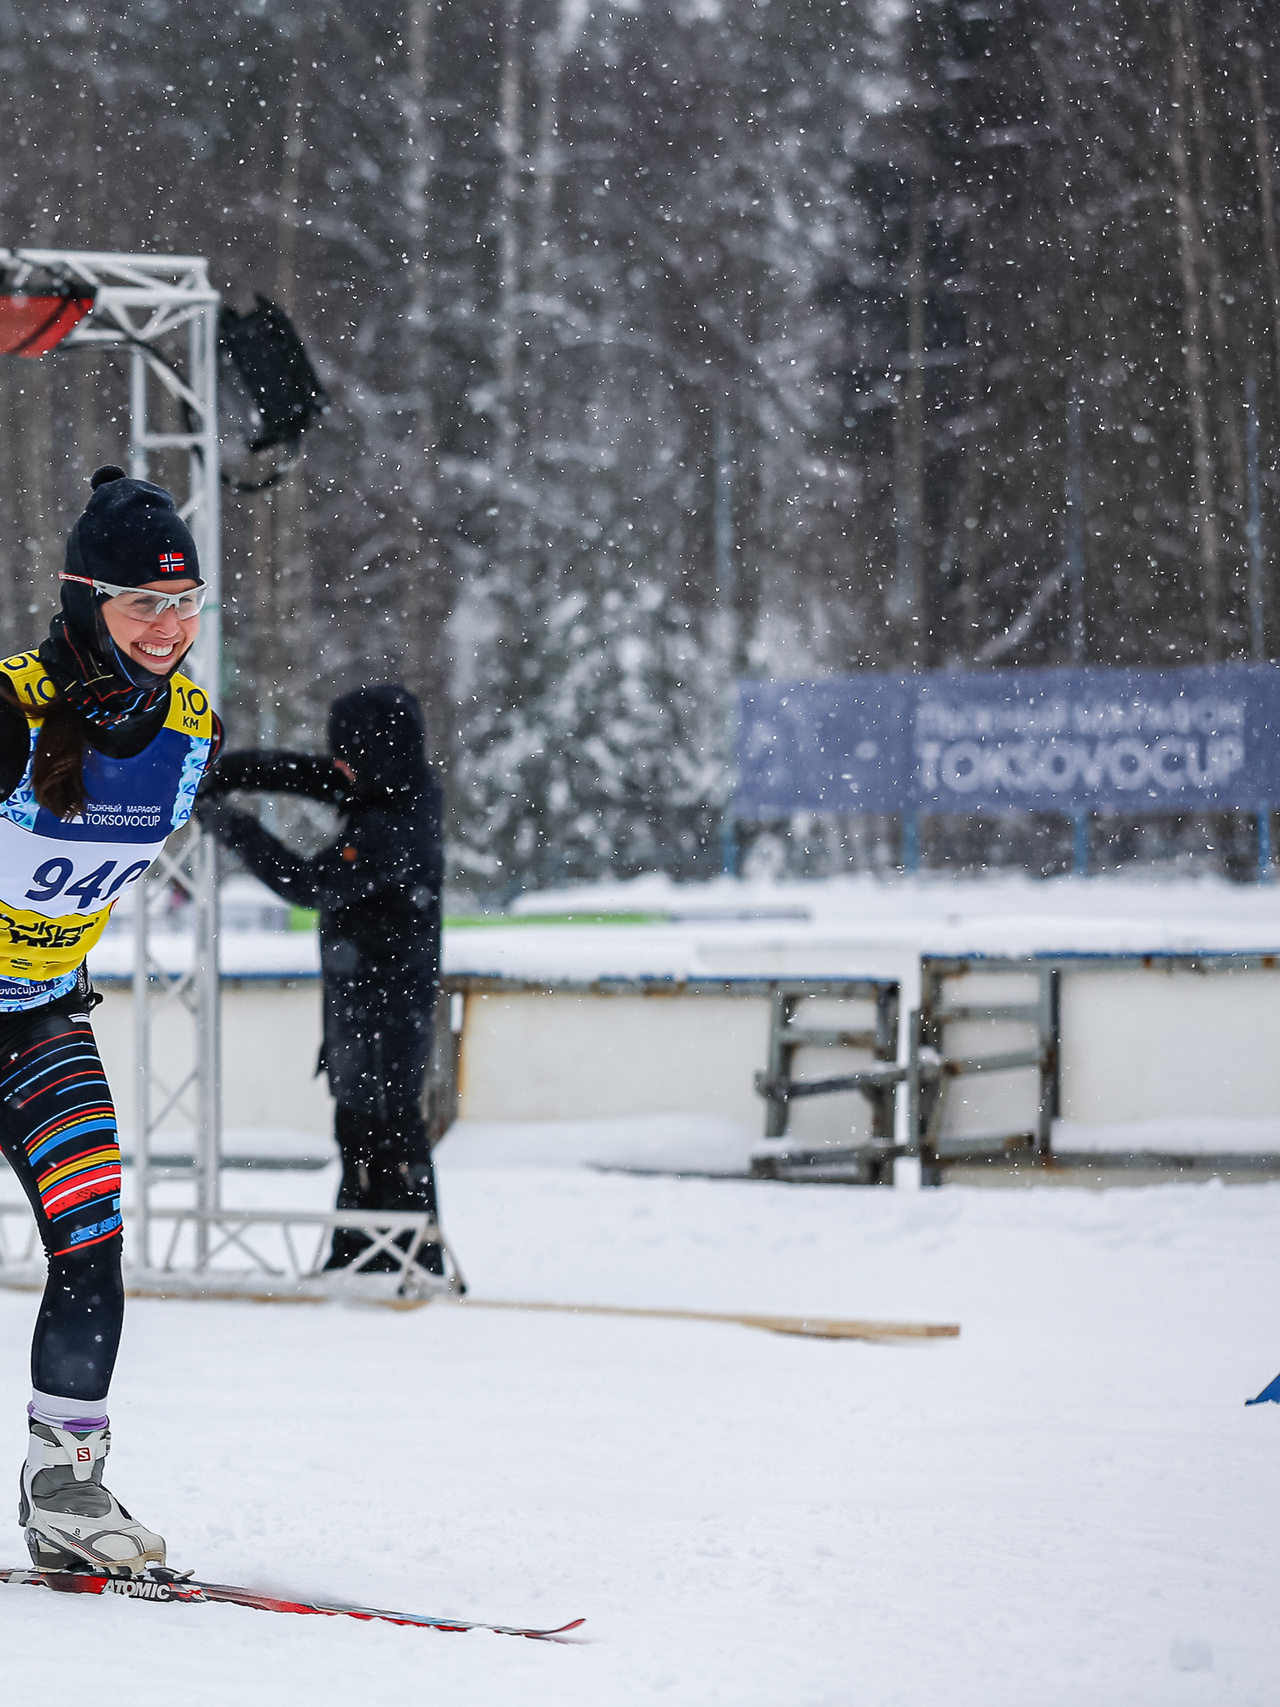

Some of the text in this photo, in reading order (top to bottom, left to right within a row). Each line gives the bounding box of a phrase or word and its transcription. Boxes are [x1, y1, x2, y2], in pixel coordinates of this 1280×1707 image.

[24, 676, 56, 705] 10
[176, 687, 208, 716] 10
[86, 812, 161, 827] TOKSOVOCUP
[127, 805, 161, 814] МАРАФОН
[101, 1579, 171, 1600] ATOMIC
